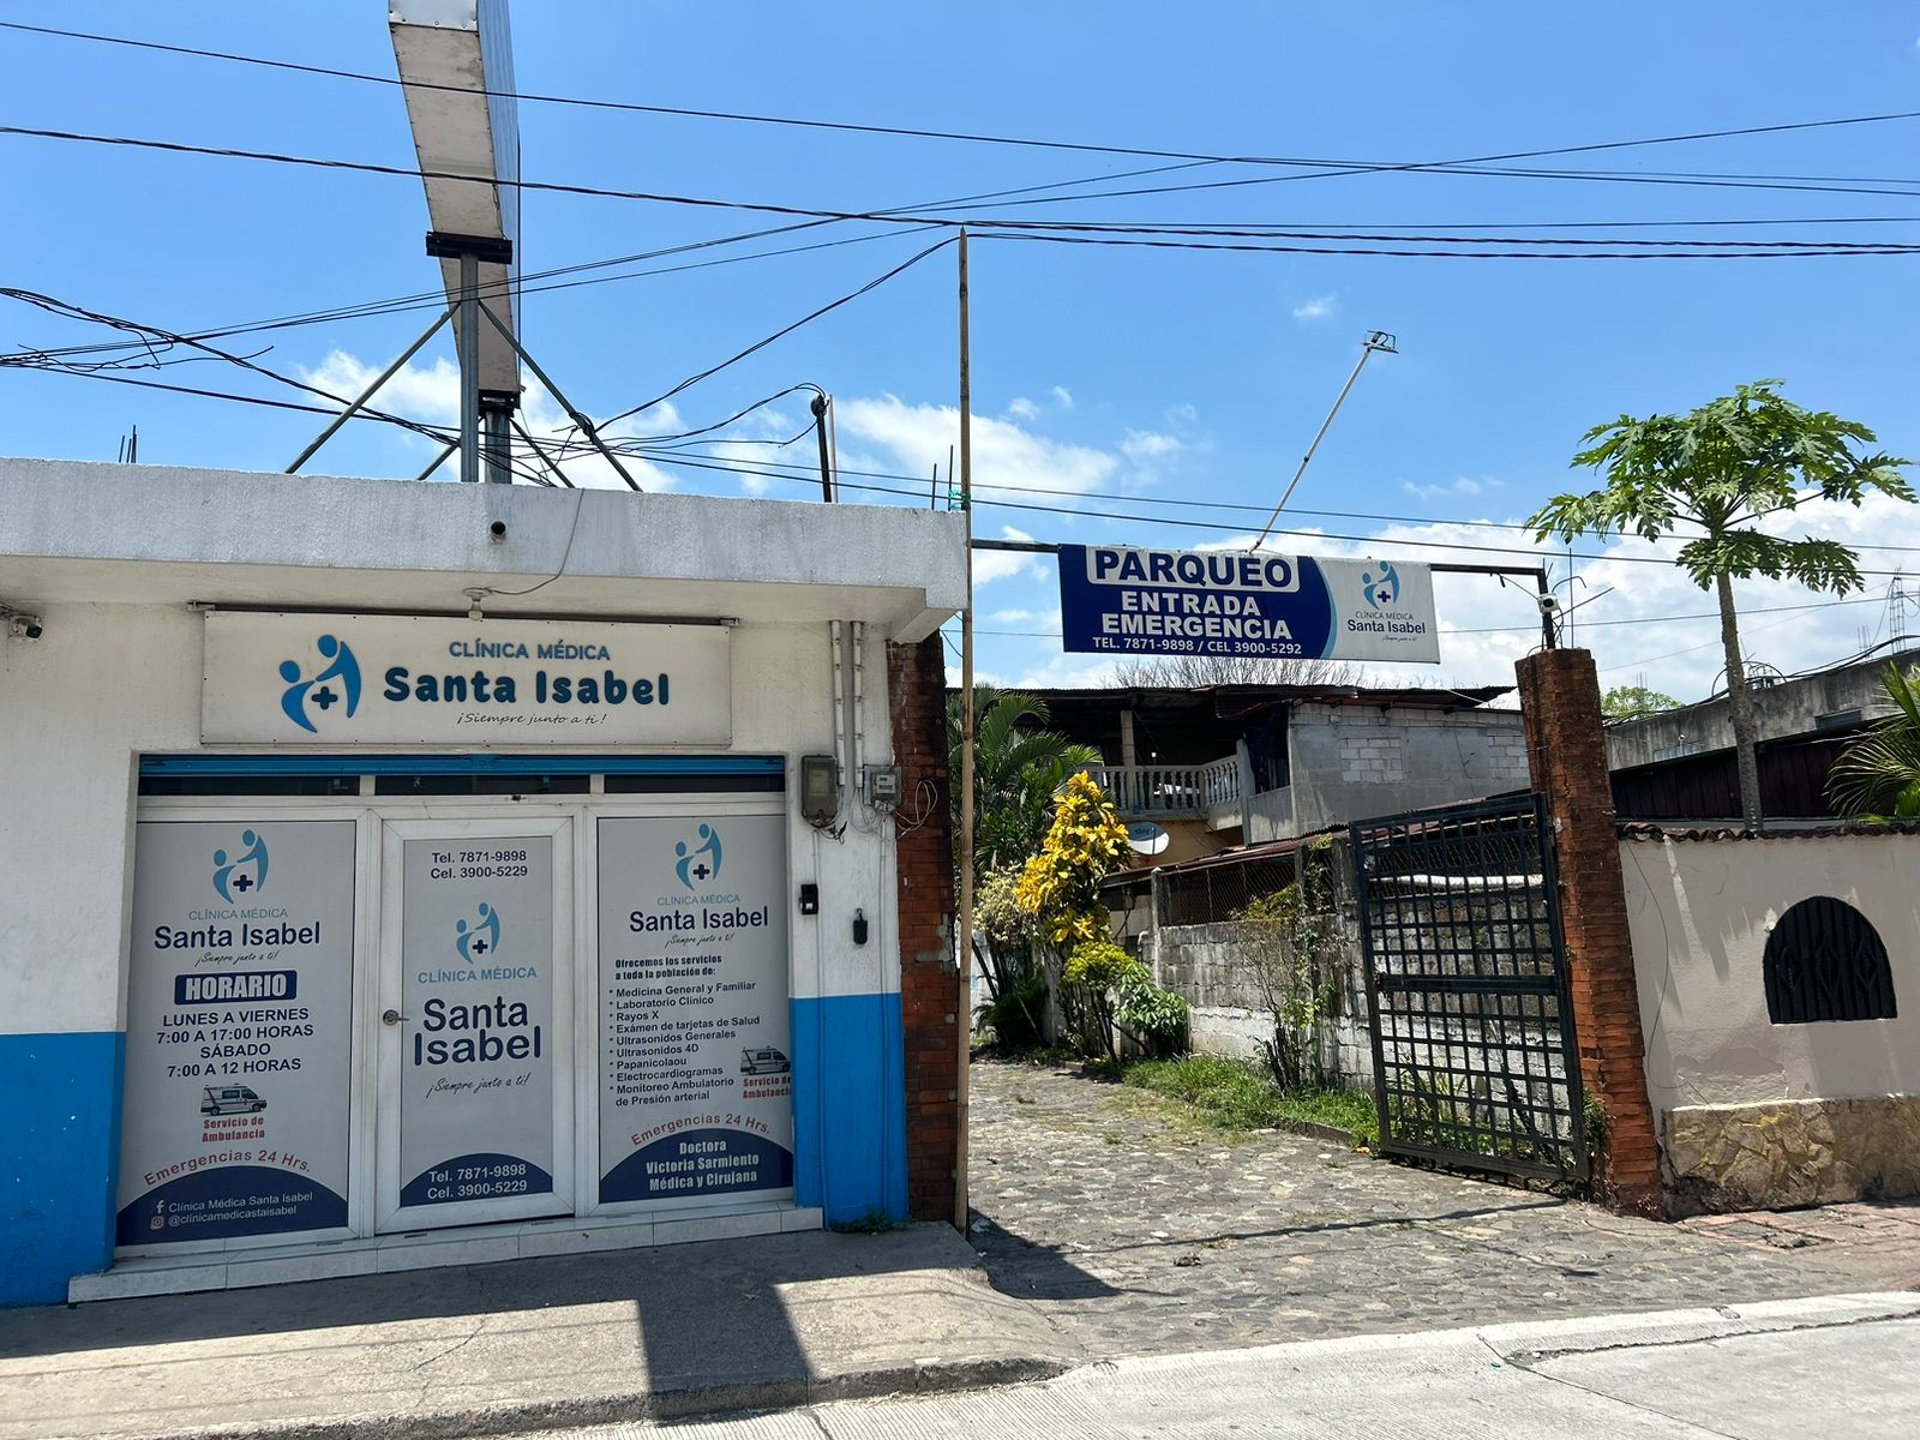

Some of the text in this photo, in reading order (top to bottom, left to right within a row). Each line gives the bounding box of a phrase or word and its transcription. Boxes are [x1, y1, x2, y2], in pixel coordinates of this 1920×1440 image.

[1095, 550, 1292, 588] PARQUEO
[1121, 591, 1261, 616] ENTRADA
[1102, 613, 1292, 640] EMERGENCIA
[1347, 619, 1426, 634] Santa Isabel
[449, 638, 611, 660] CLÍNICA MÉDICA
[1092, 637, 1302, 655] TEL. 7871-9898 / CEL 3900-5292
[383, 666, 669, 705] Santa Isabel
[527, 713, 568, 726] junto
[570, 716, 581, 724] a
[432, 850, 527, 864] Tel. 7871-9898
[430, 865, 528, 879] Cel. 3900-5229
[657, 896, 698, 906] CLÍNICA
[189, 907, 288, 921] CLÍNICA MÉDICA
[629, 906, 768, 932] Santa Isabel
[154, 921, 320, 949] Santa Isabel
[615, 954, 722, 968] Ofrecemos los servicios
[418, 966, 537, 984] CLÍNICA MÉDICA
[615, 966, 716, 980] a toda la población de:
[185, 973, 287, 1000] HORARIO
[616, 981, 756, 997] Medicina General y Familiar
[616, 996, 714, 1009] Laboratorio Clínico
[163, 1007, 309, 1027] LUNES A VIERNES
[423, 996, 528, 1031] Santa
[616, 1010, 659, 1023] Rayos X
[616, 1016, 760, 1034] Exámen de tarjetas de Salud
[157, 1024, 314, 1044] 7:00 A 17:00 HORAS
[616, 1030, 736, 1045] Ultrasonidos Generales
[200, 1043, 271, 1059] SÁBADO
[414, 1025, 541, 1066] Isabel
[616, 1044, 699, 1058] Ultrasonidos 4D
[167, 1058, 301, 1078] 7:00 A 12 HORAS
[616, 1058, 687, 1071] Papanicolaou
[616, 1066, 723, 1082] Electrocardiogramas
[743, 1076, 780, 1087] Servicio
[474, 1077, 502, 1094] junto
[505, 1079, 512, 1087] a
[616, 1078, 734, 1095] Monitoreo Ambulatorio
[616, 1091, 710, 1107] de Presión arterial
[203, 1116, 264, 1129] Servicio de
[631, 1113, 771, 1146] Emergencias 24 Hrs.
[202, 1129, 265, 1142] Ambulancia
[679, 1140, 727, 1155] Doctora
[144, 1149, 311, 1186] Emergencias 24 Hrs.
[646, 1153, 759, 1174] Victoria Sarmiento
[429, 1164, 526, 1183] Tel. 7871-9898
[649, 1170, 757, 1191] Médica y Cirujana
[427, 1180, 527, 1200] Cel. 3900-5229
[208, 1199, 246, 1209] Médica
[249, 1196, 279, 1206] Santa
[282, 1192, 313, 1203] Isabel
